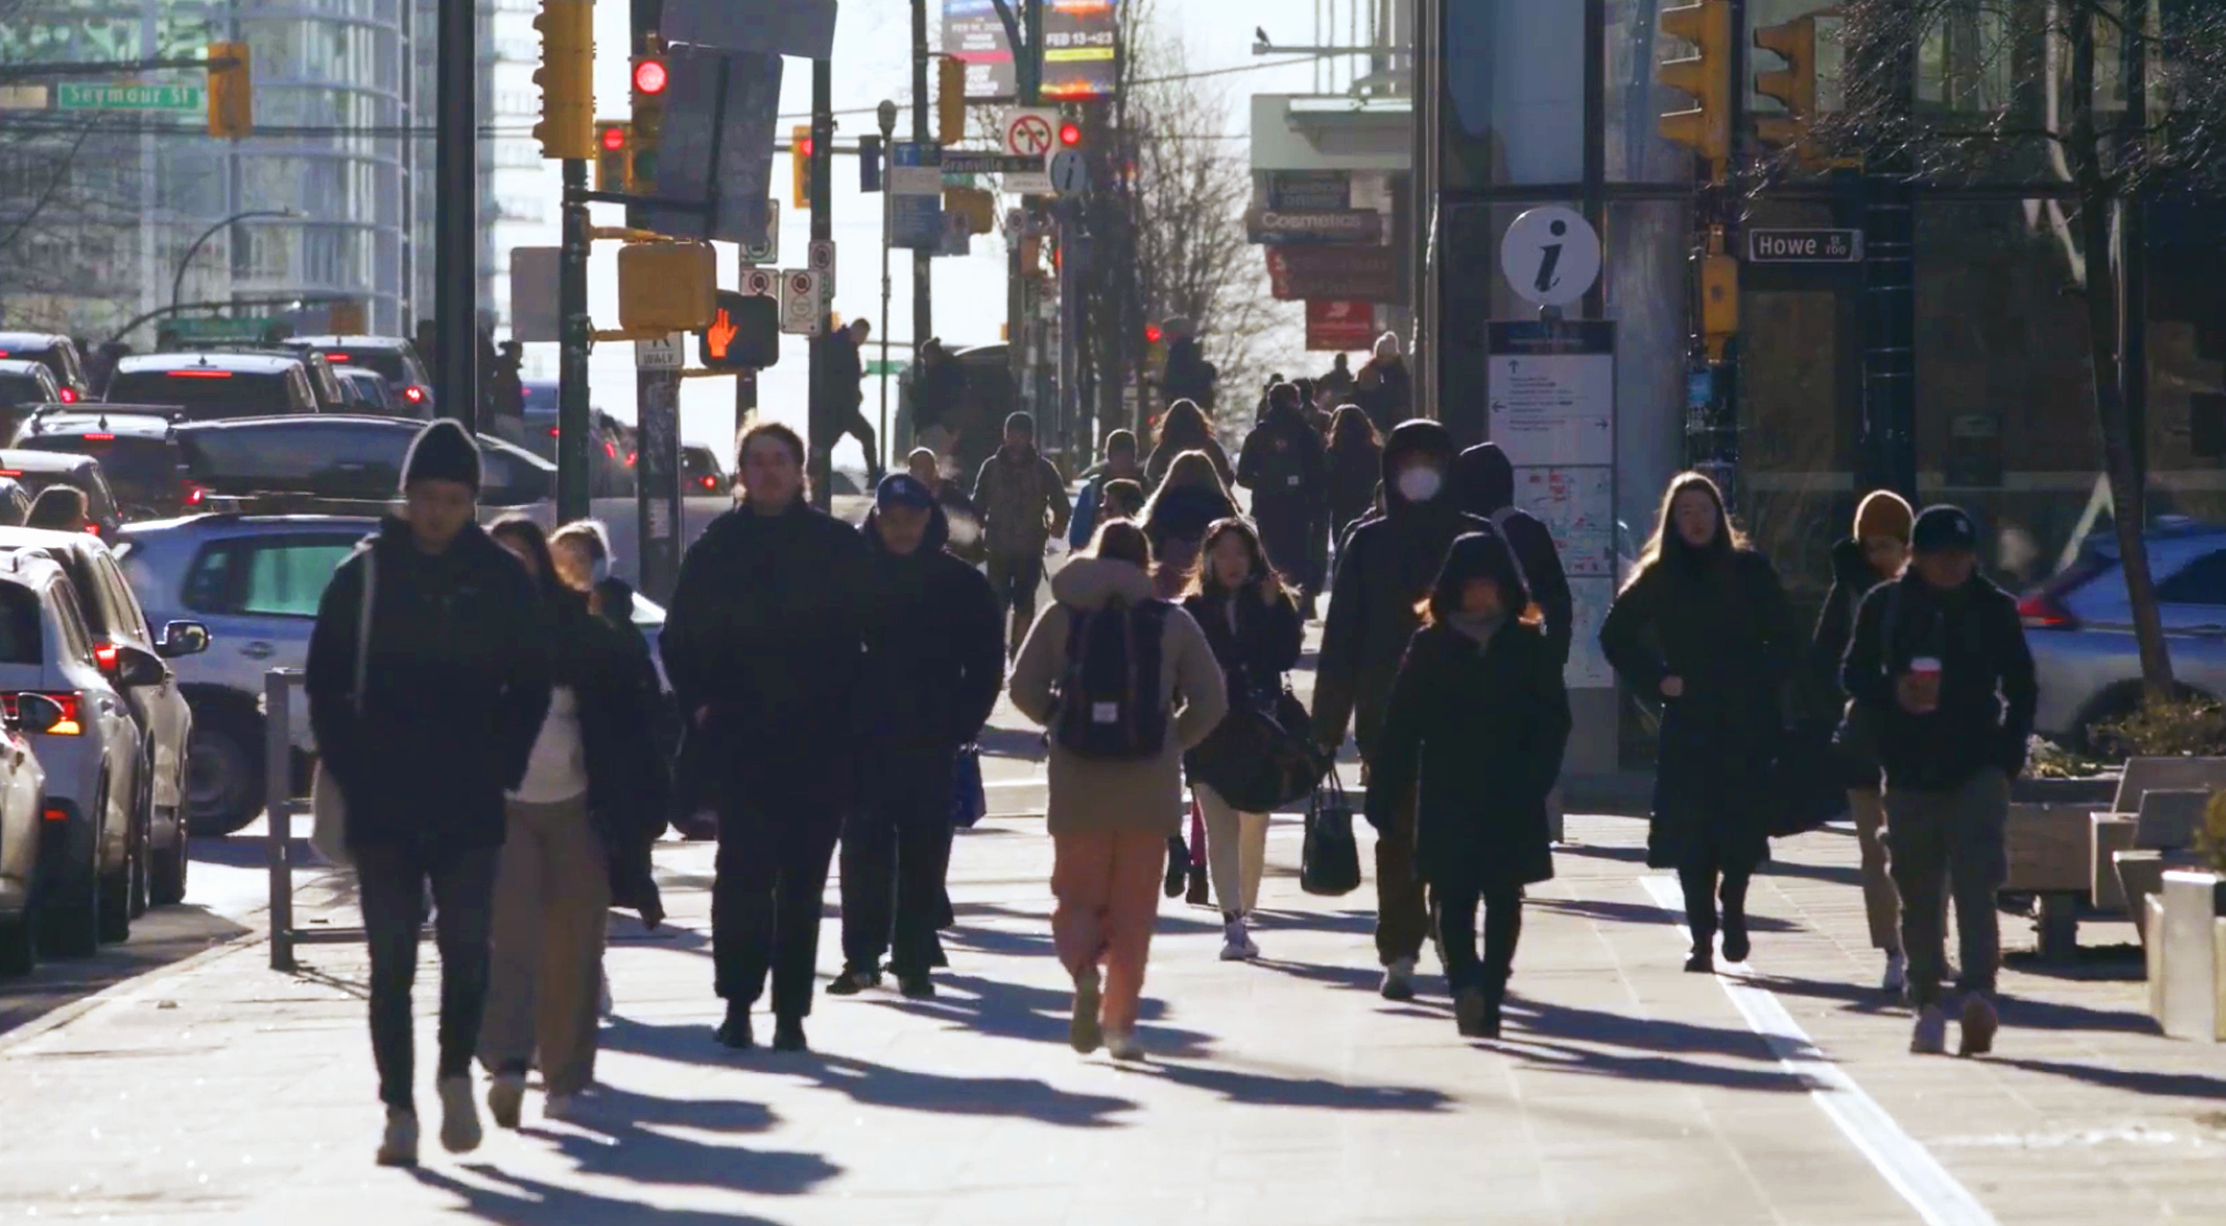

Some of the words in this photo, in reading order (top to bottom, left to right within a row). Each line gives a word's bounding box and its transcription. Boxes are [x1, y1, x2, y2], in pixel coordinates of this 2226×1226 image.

[1046, 32, 1070, 47] FEB
[70, 84, 161, 106] Seymour
[171, 85, 189, 101] St
[1262, 211, 1361, 229] Cosmetics
[1759, 235, 1817, 255] Howe
